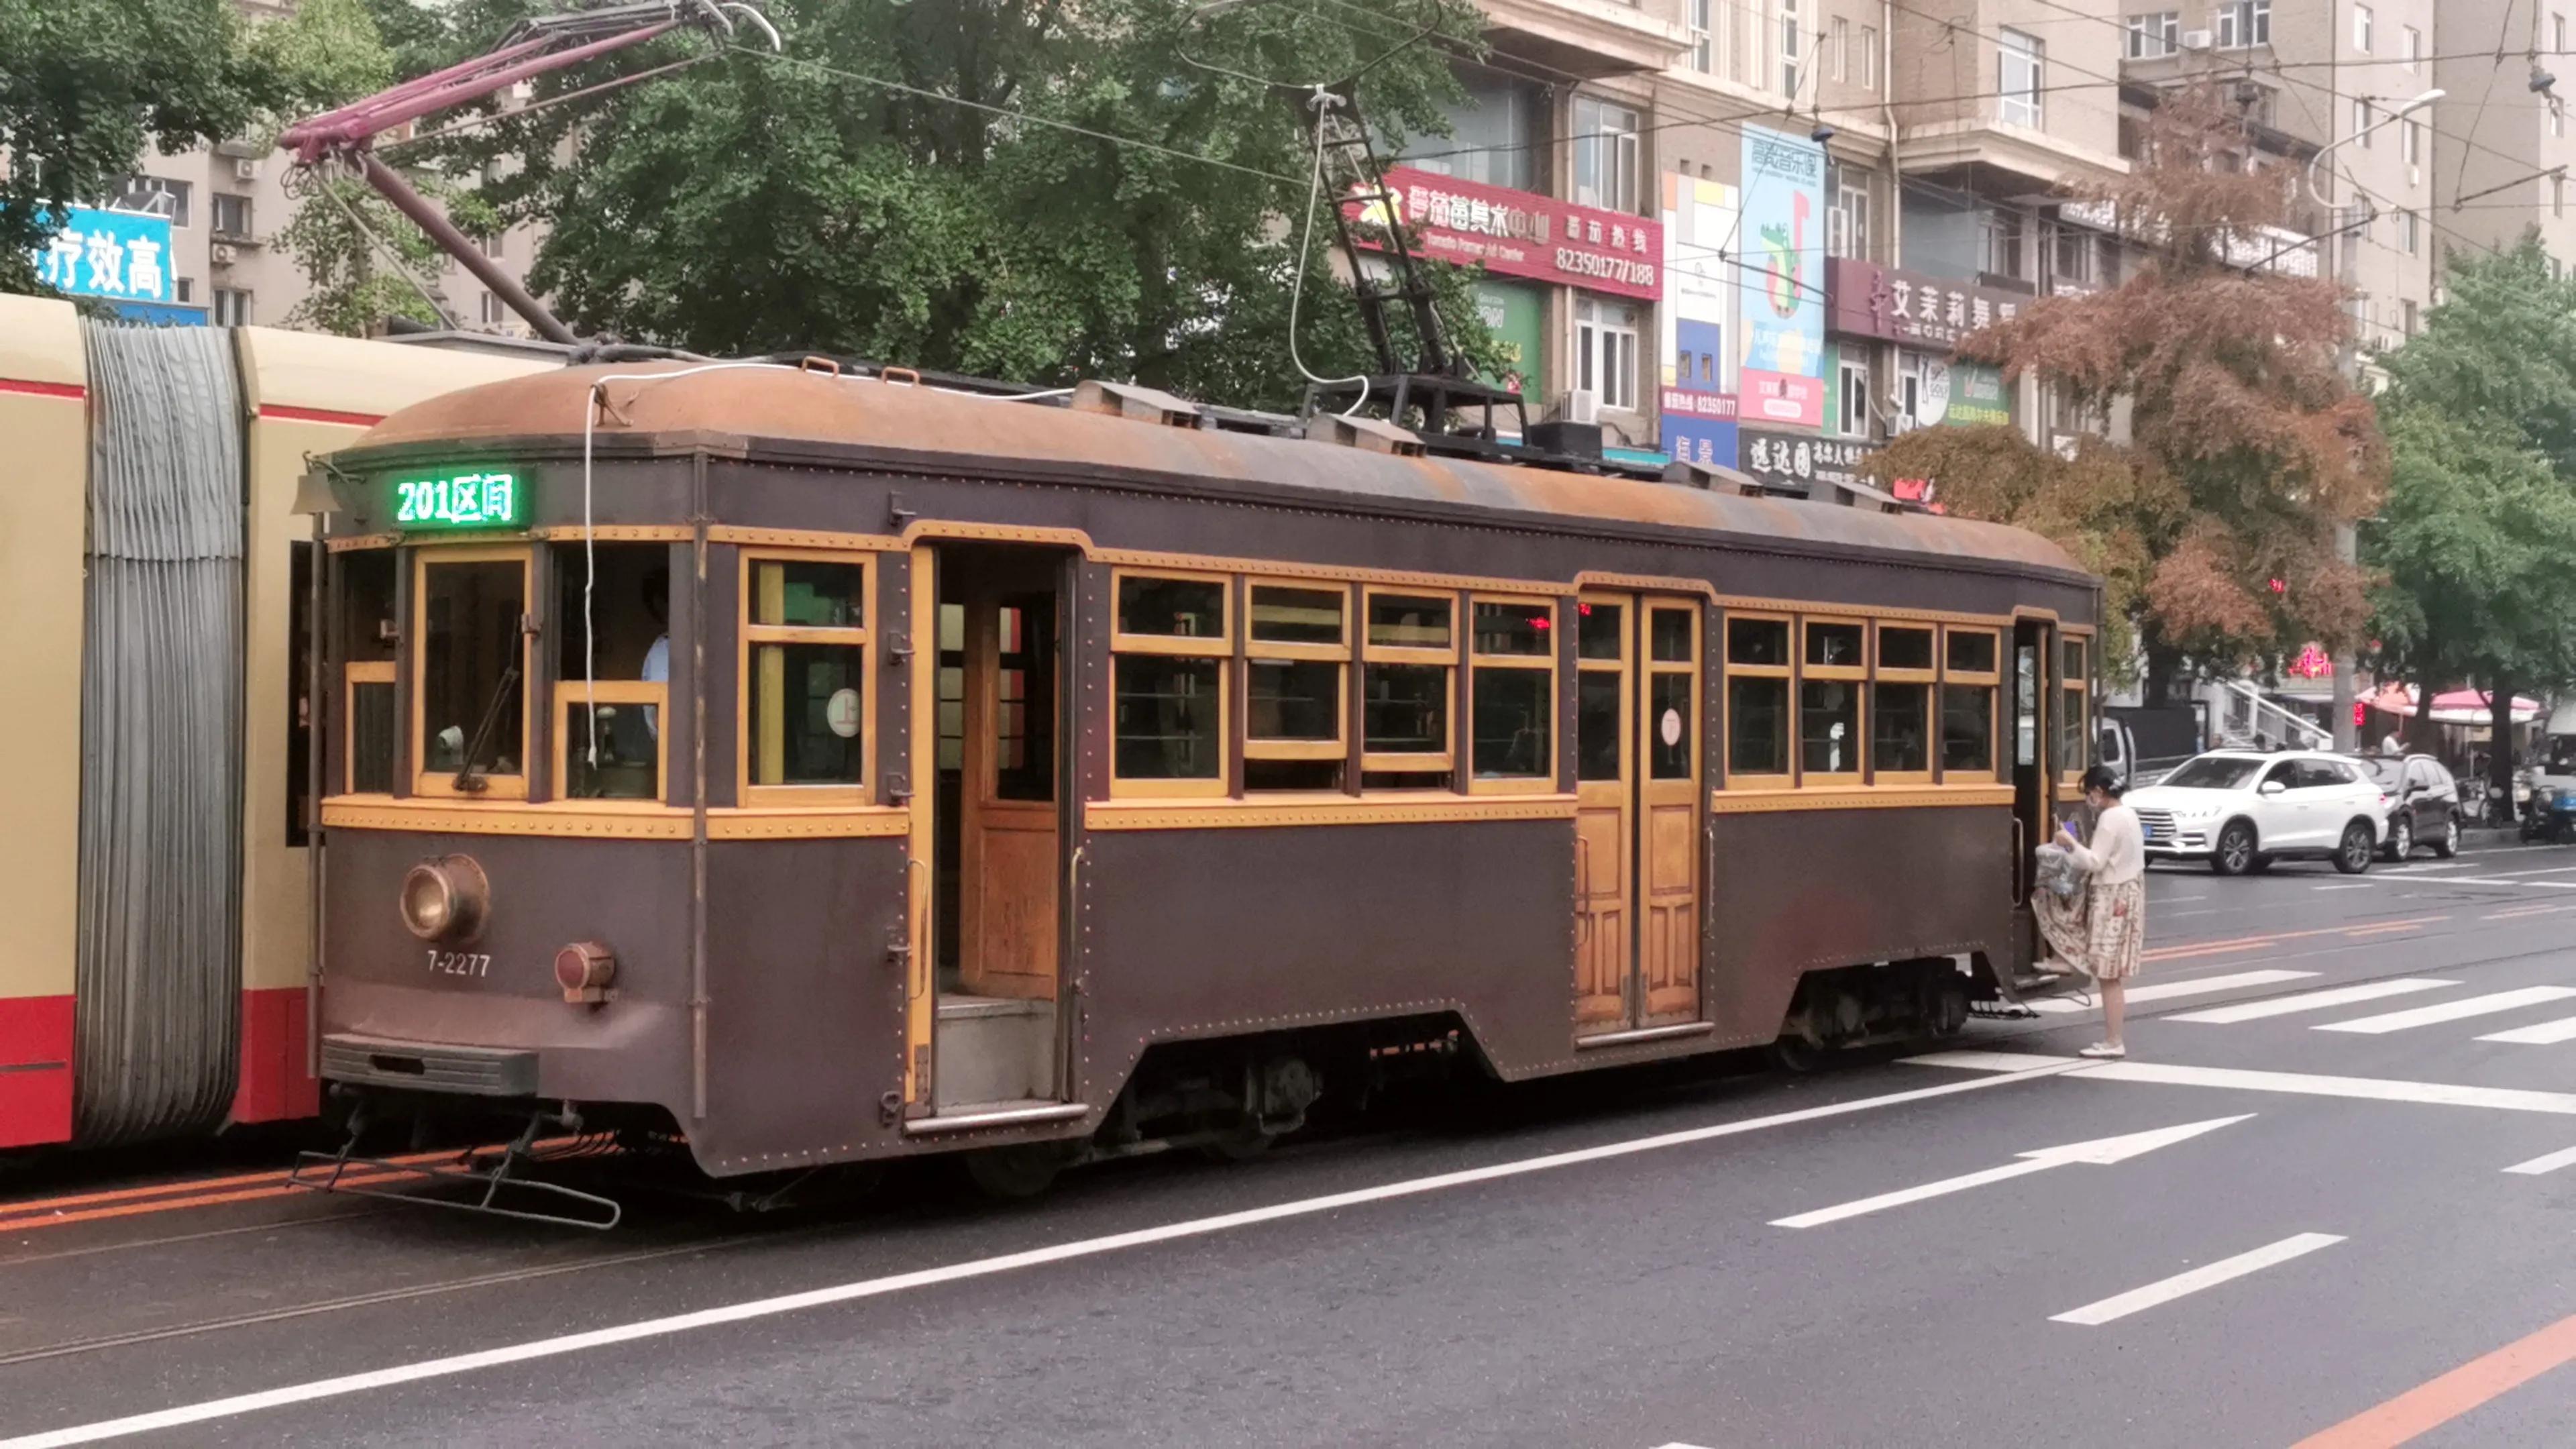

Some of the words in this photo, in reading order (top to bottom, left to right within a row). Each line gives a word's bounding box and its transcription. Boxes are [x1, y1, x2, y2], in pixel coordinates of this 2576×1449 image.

[32, 227, 163, 299] 疗效高
[1556, 247, 1654, 286] 82350177/188
[397, 474, 513, 523] 201区间
[427, 949, 491, 977] 7-2277
